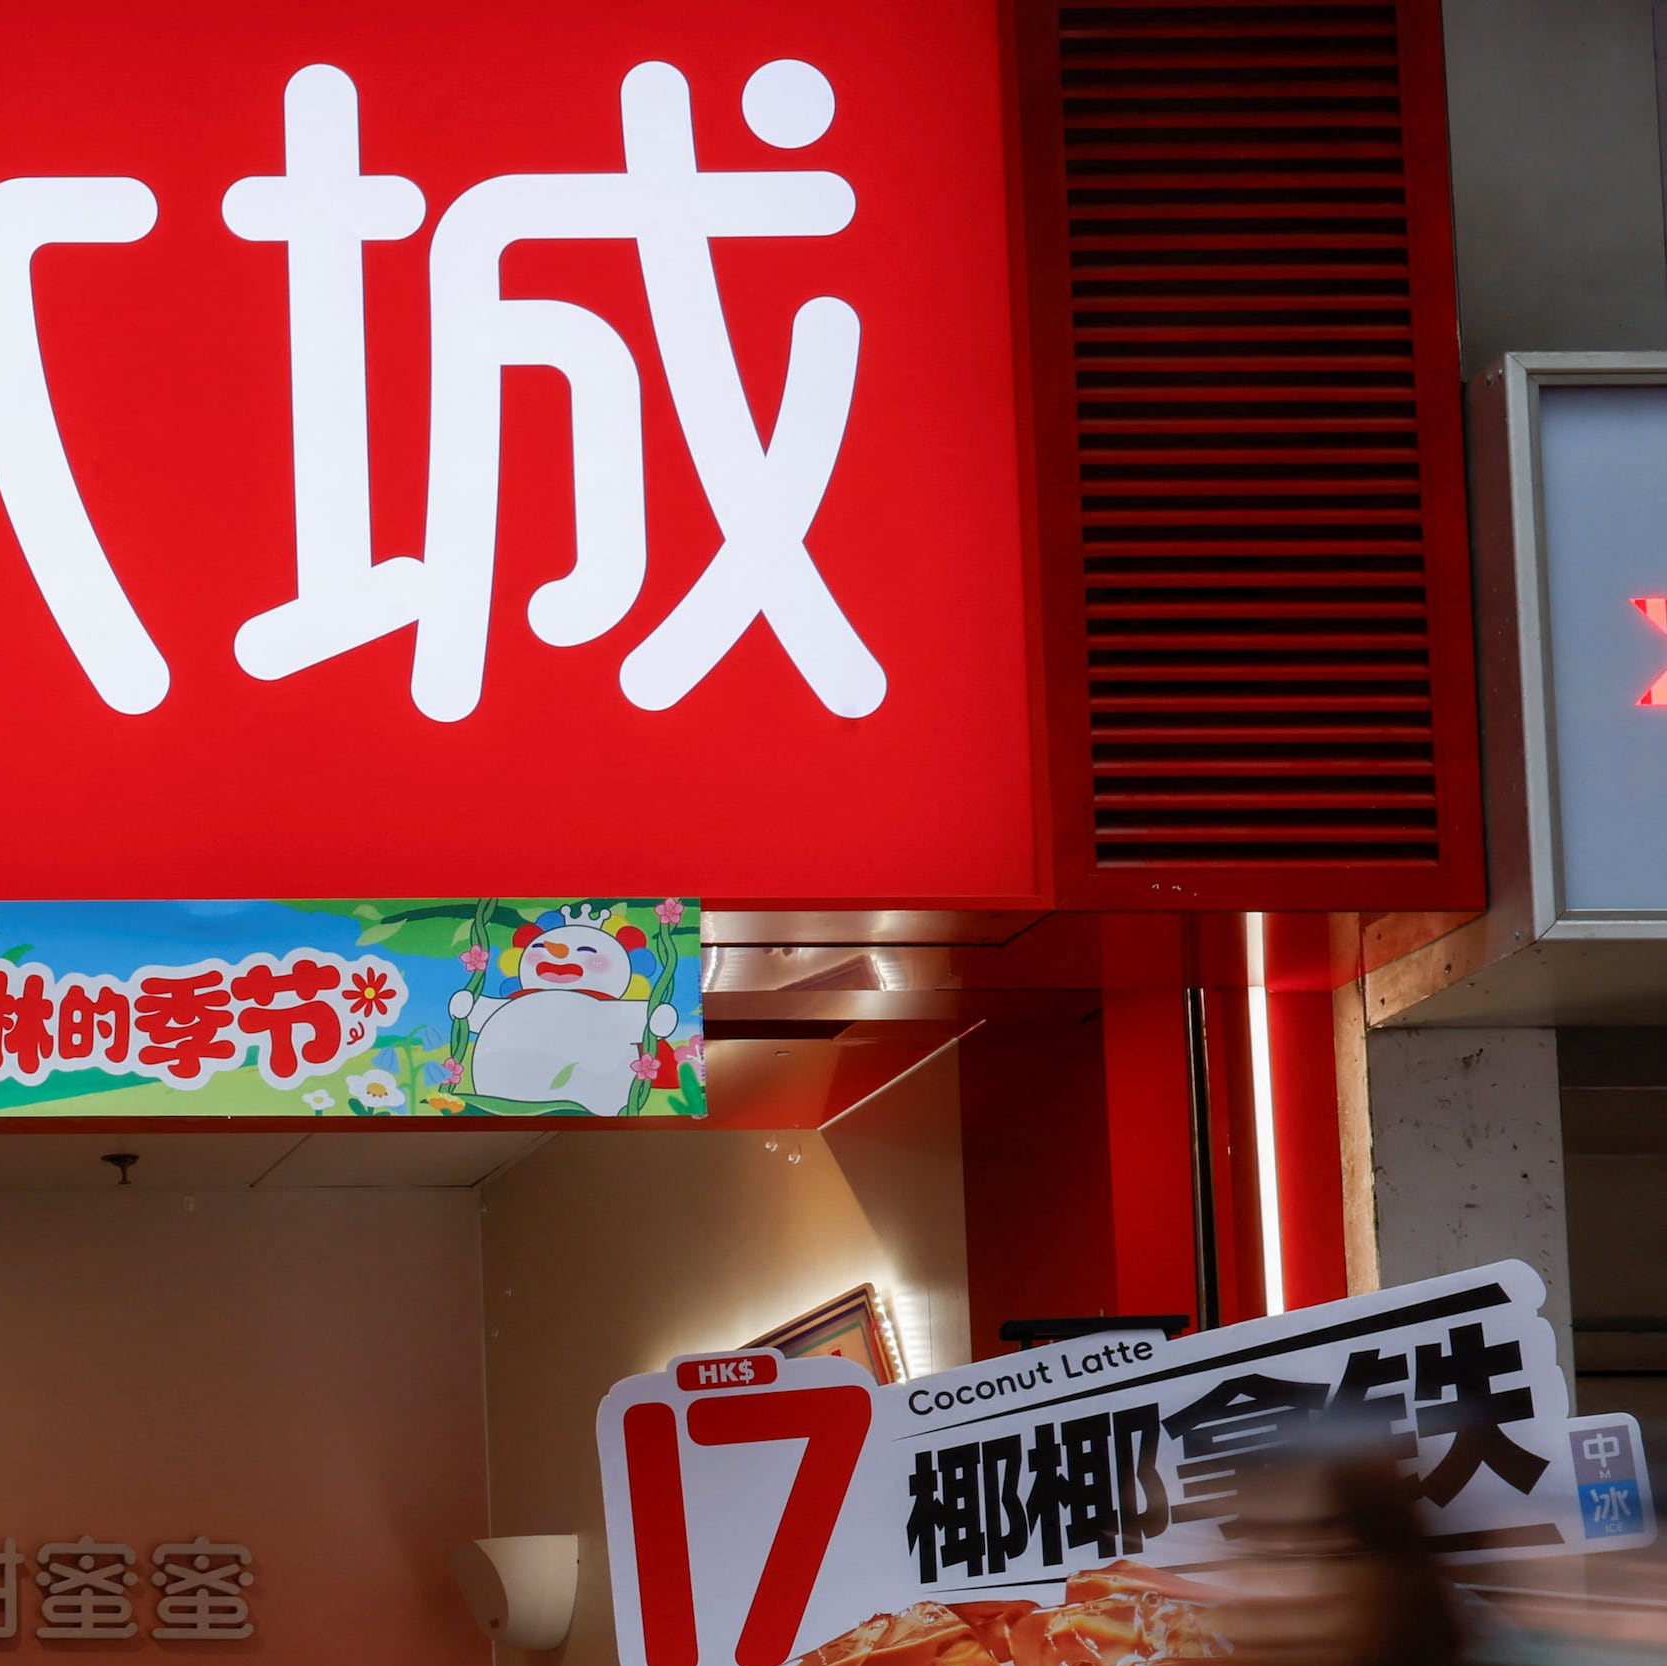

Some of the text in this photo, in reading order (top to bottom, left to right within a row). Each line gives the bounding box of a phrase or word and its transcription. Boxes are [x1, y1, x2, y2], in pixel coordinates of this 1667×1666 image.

[698, 1359, 755, 1387] HK$
[908, 1338, 1156, 1417] Coconut Latte
[1583, 1432, 1621, 1467] 中
[1600, 1469, 1611, 1478] M
[1595, 1486, 1633, 1523] 冰
[1605, 1523, 1624, 1533] ICE
